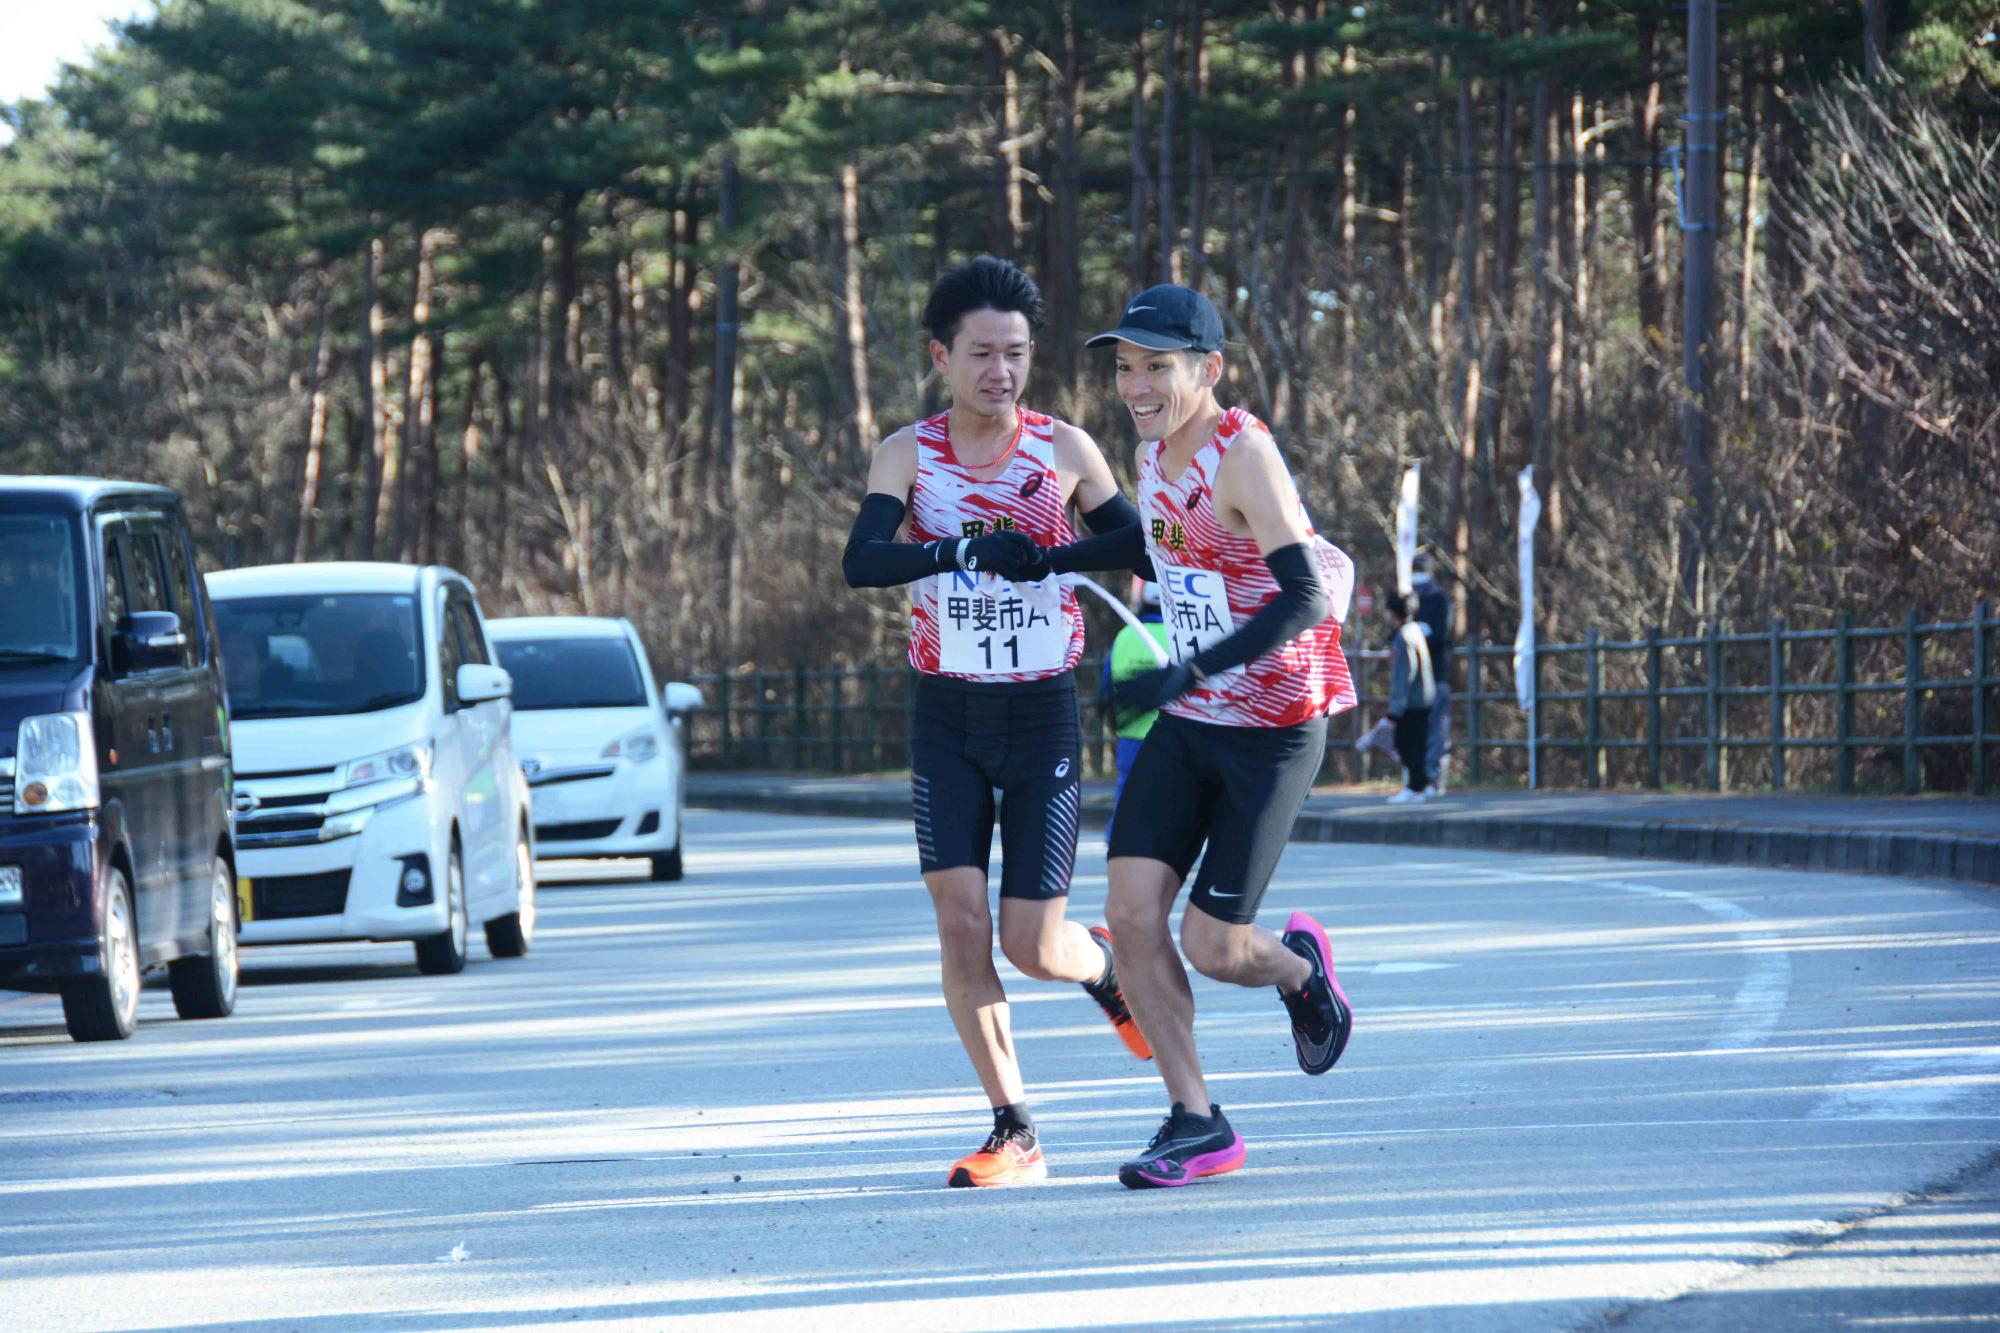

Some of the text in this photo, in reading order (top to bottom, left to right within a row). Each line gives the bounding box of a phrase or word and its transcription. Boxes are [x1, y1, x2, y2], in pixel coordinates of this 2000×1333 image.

[1151, 518, 1187, 552] 甲斐
[1165, 570, 1211, 599] EC
[948, 597, 1050, 632] 甲斐市A
[1171, 599, 1225, 633] 市A
[977, 635, 1019, 670] 11
